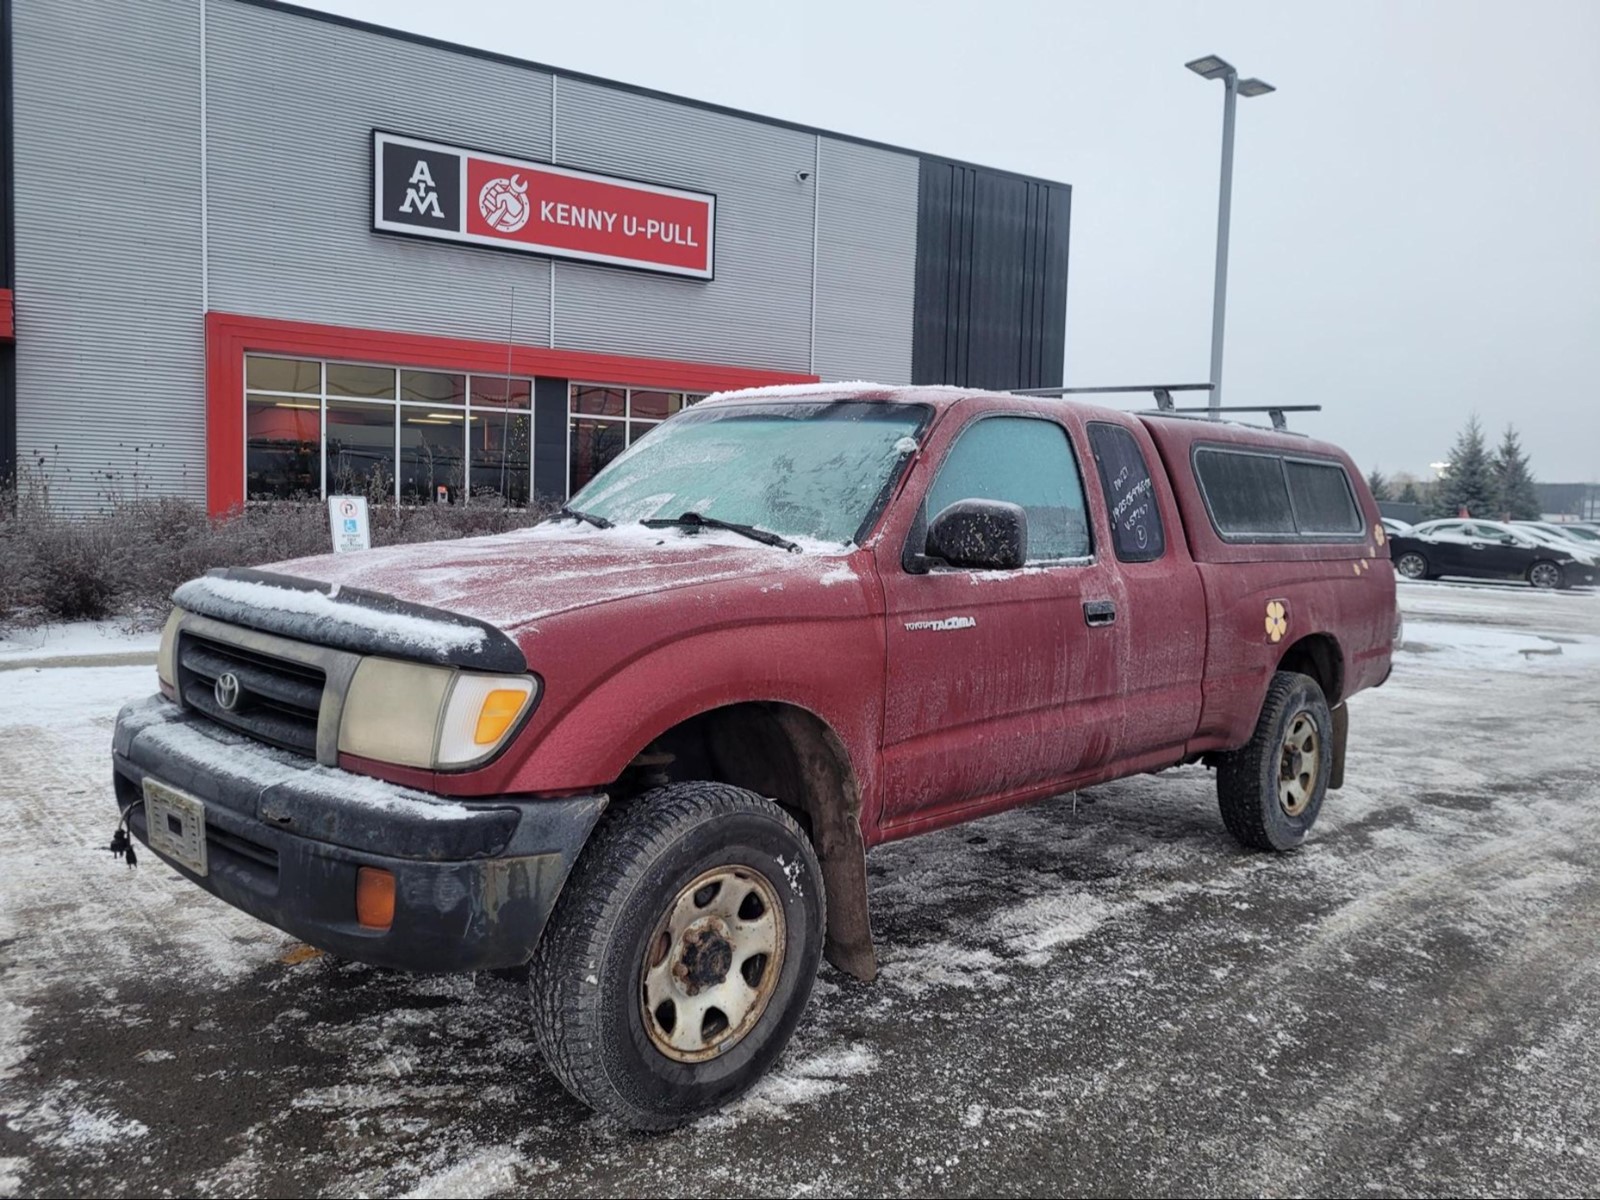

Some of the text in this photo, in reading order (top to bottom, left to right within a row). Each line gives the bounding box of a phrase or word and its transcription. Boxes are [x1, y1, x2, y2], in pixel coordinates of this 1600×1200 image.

[540, 200, 698, 247] KENNY U-PULL
[931, 616, 976, 631] TACOMA
